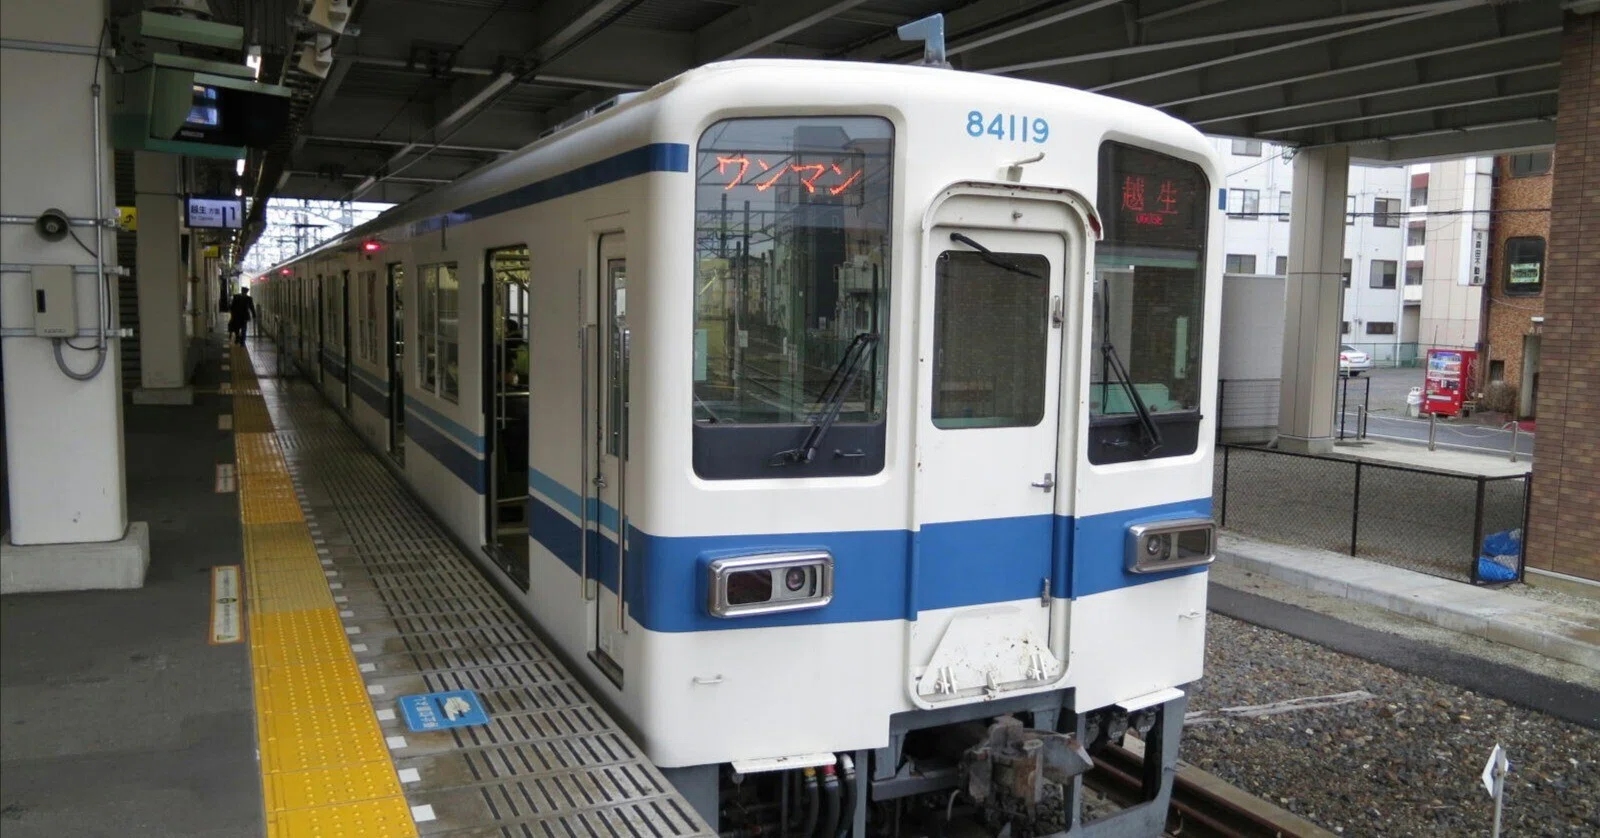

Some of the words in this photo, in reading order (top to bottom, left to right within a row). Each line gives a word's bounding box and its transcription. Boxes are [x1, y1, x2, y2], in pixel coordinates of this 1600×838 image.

[966, 111, 1049, 143] 84119
[717, 156, 862, 195] ワンマン
[1121, 176, 1178, 214] 越生
